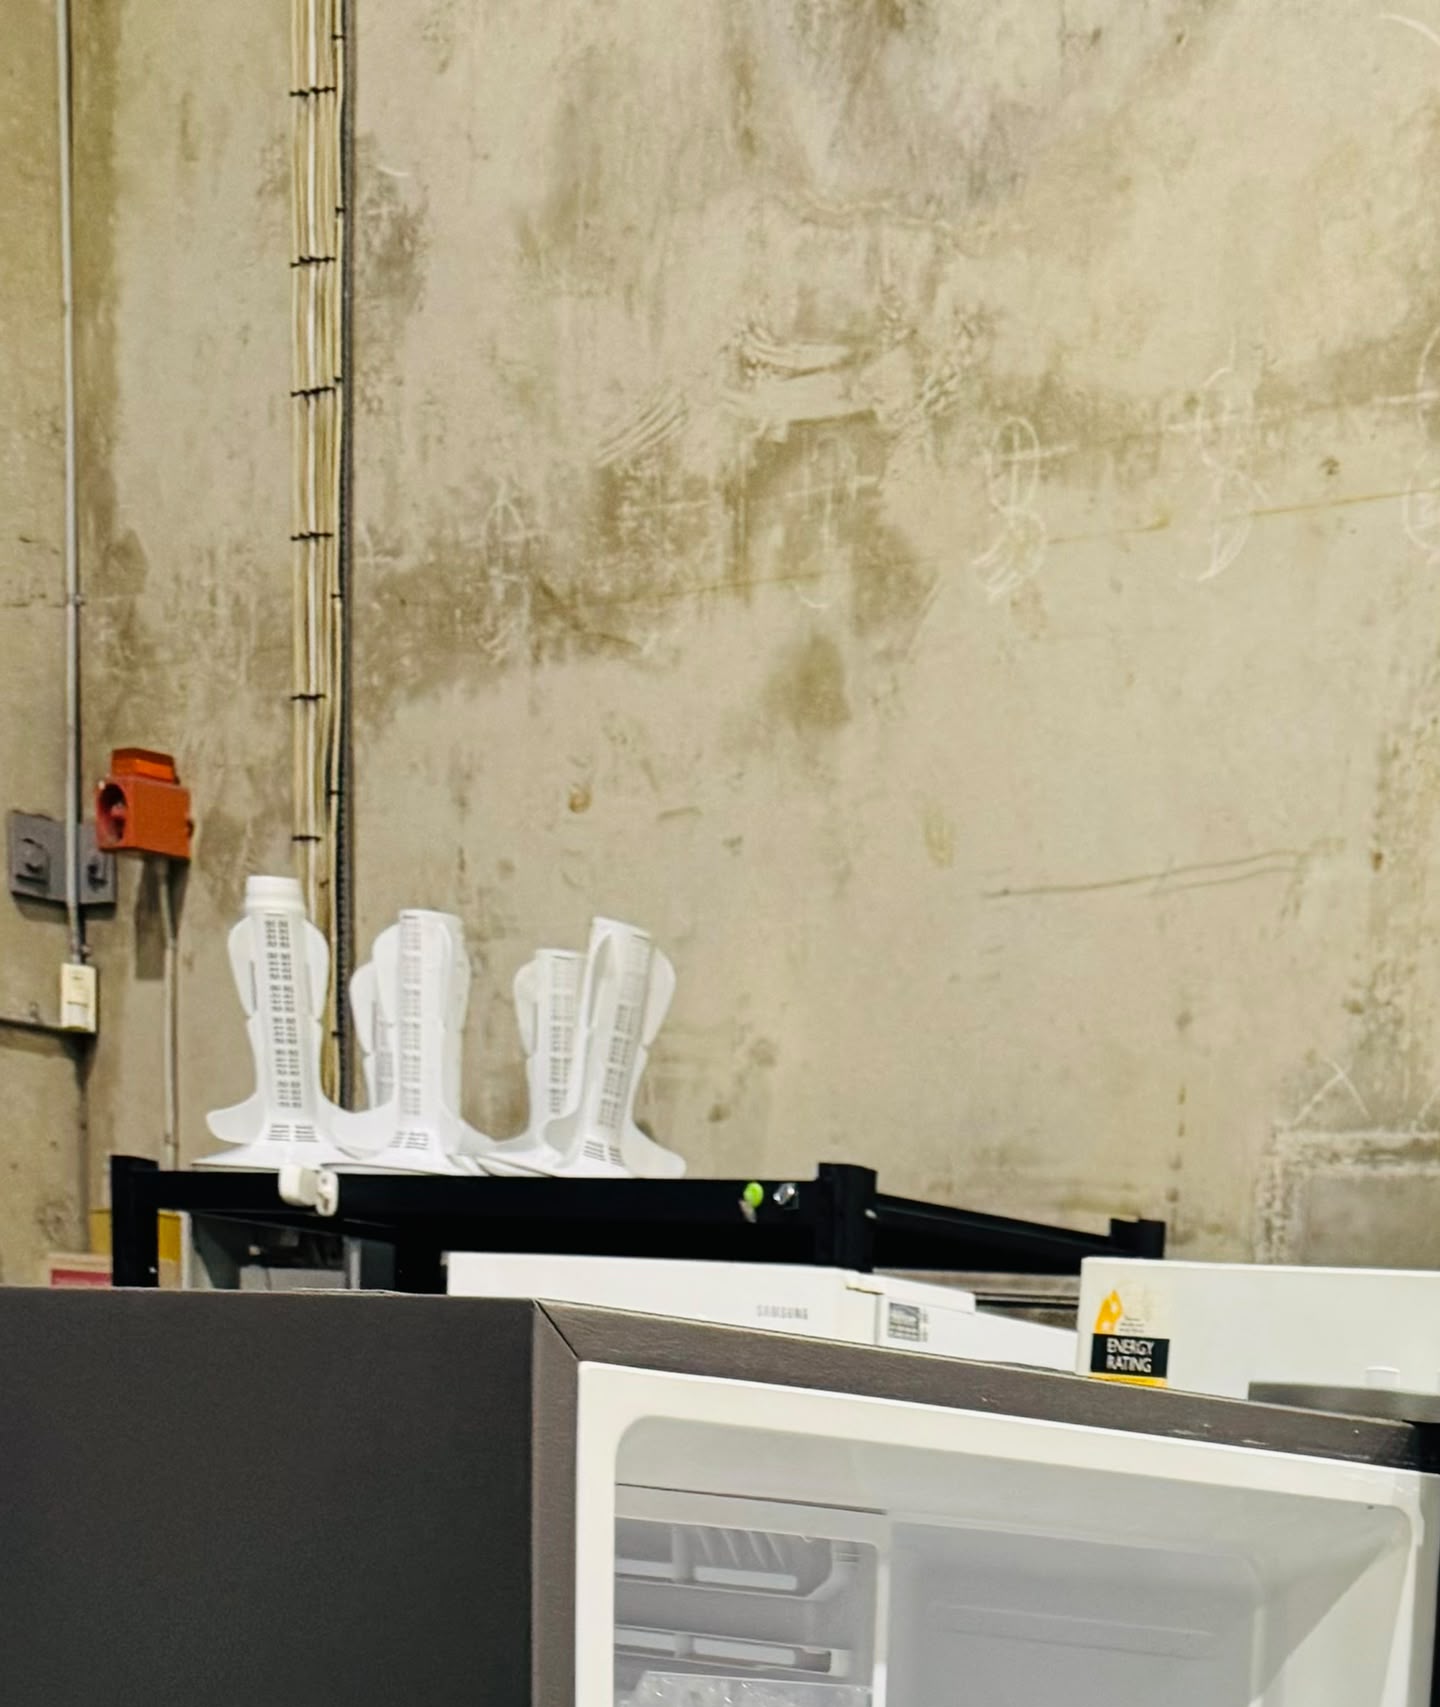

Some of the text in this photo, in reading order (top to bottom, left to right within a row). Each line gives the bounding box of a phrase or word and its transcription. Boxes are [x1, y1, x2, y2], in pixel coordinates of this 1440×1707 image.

[756, 1304, 808, 1320] SAMSUNG
[1106, 1337, 1155, 1356] ENERGY
[1106, 1354, 1153, 1373] RATING
